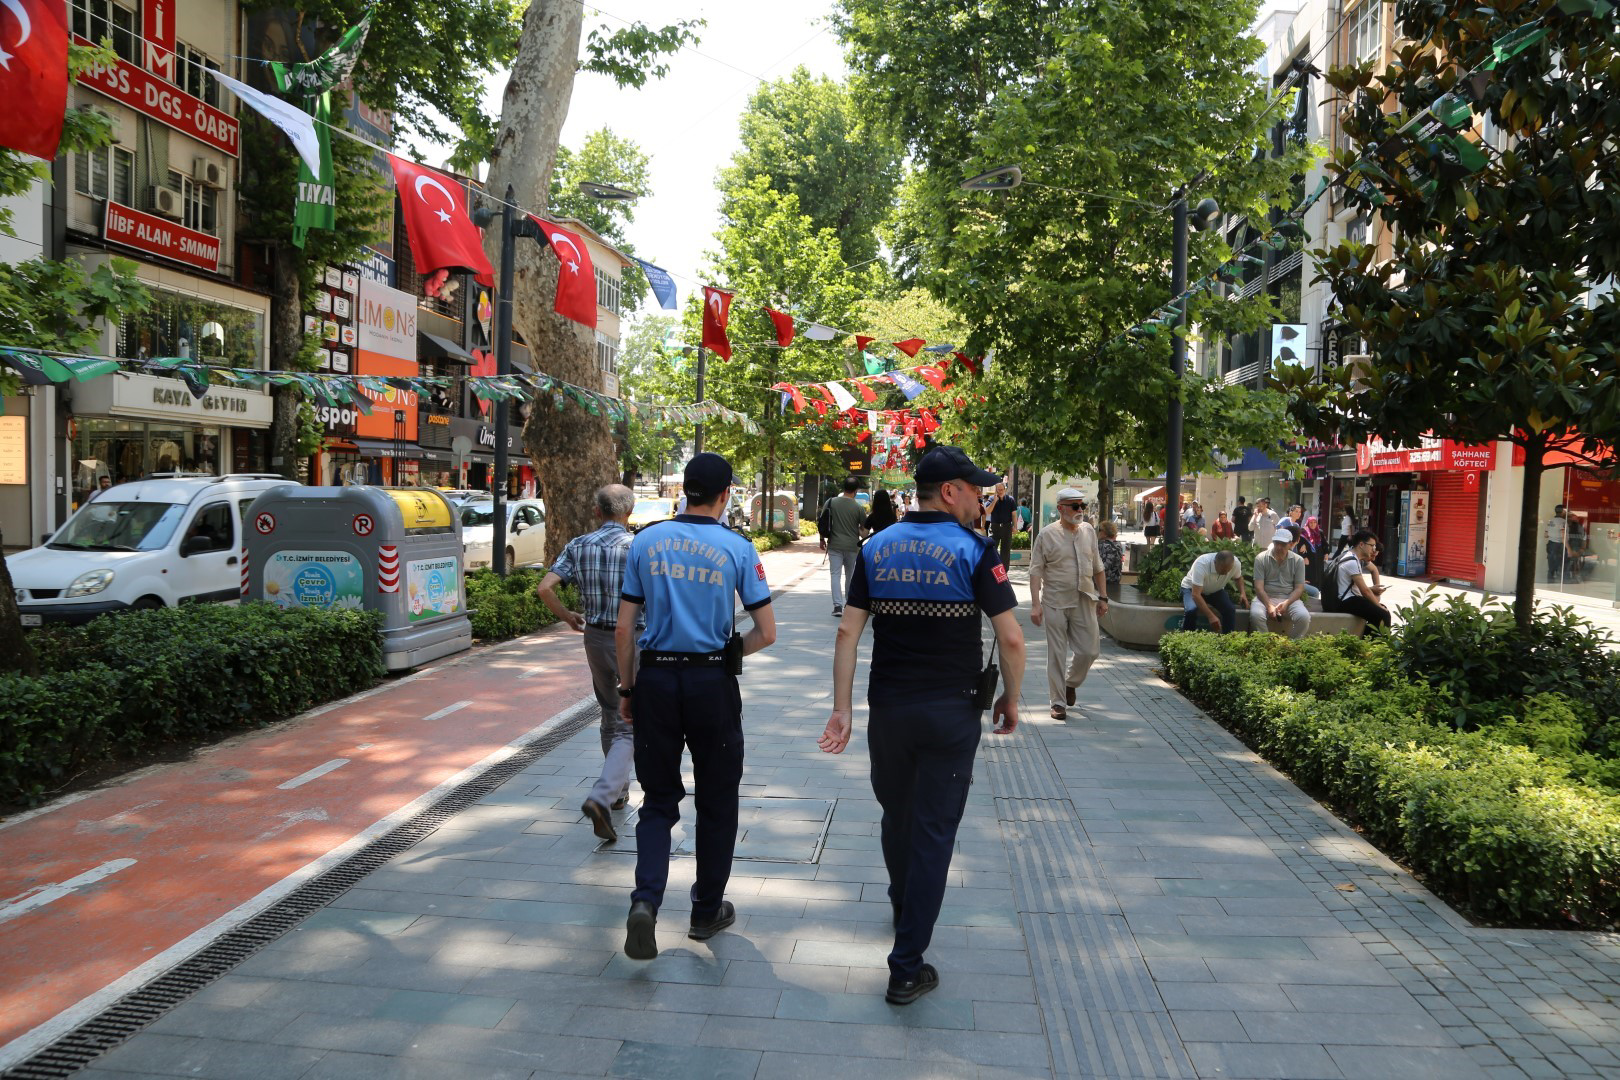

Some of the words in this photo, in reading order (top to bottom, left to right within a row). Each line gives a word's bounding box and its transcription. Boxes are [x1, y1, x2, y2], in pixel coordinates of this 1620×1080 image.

[145, 0, 175, 83] İM
[145, 82, 182, 120] DGS
[194, 103, 237, 146] ÖABT
[136, 222, 172, 248] ALAN
[179, 236, 217, 262] SMMM
[153, 387, 191, 406] KAYA
[1451, 450, 1491, 459] ŞAHHANE
[1453, 459, 1487, 467] KÖFTECİ
[295, 554, 314, 562] İZMİT
[315, 554, 350, 562] BELEDİYESİ
[649, 560, 724, 586] ZABITA
[874, 568, 950, 586] ZABITA
[299, 579, 326, 588] Çevre
